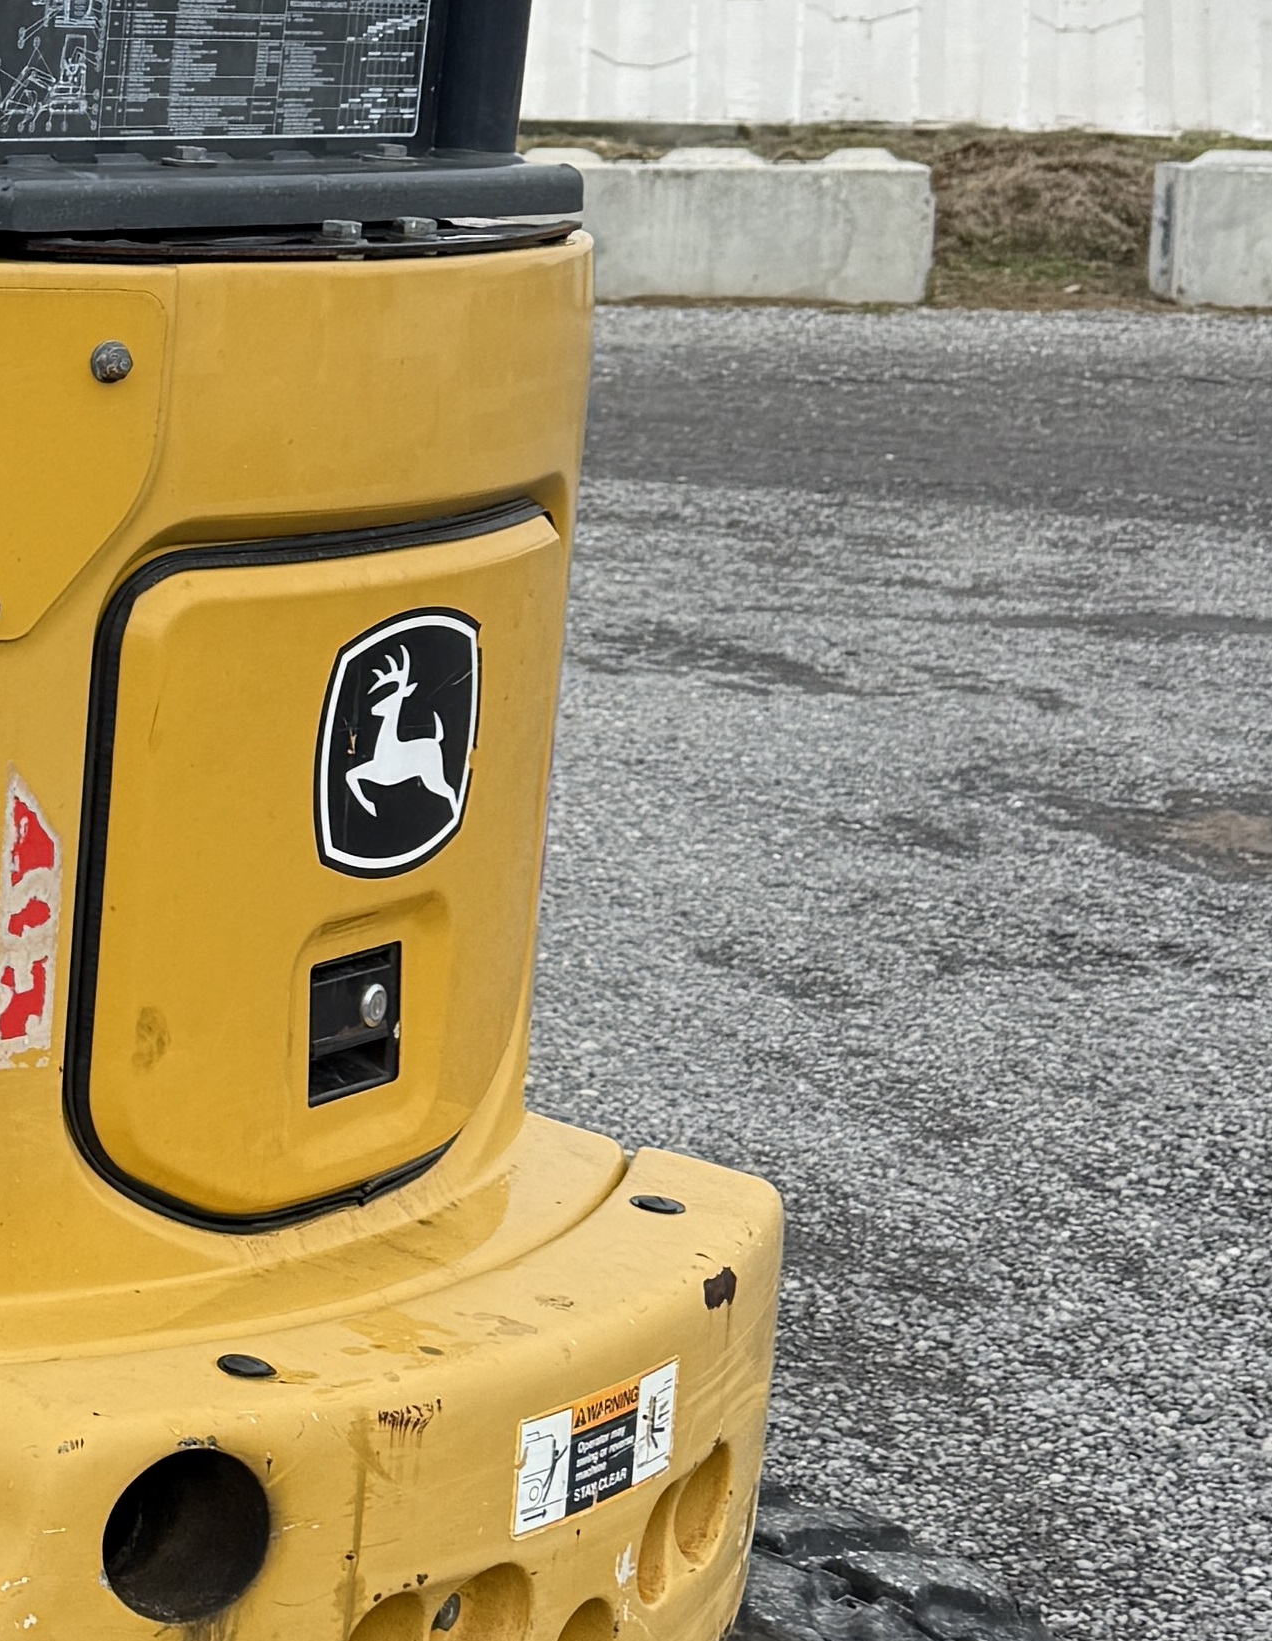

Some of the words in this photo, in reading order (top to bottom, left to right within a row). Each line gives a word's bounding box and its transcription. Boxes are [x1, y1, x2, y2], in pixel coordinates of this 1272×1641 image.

[587, 1385, 639, 1422] WARNING
[577, 1433, 610, 1454] Operator
[574, 1481, 598, 1502] STAY
[598, 1467, 628, 1491] CLEAR
